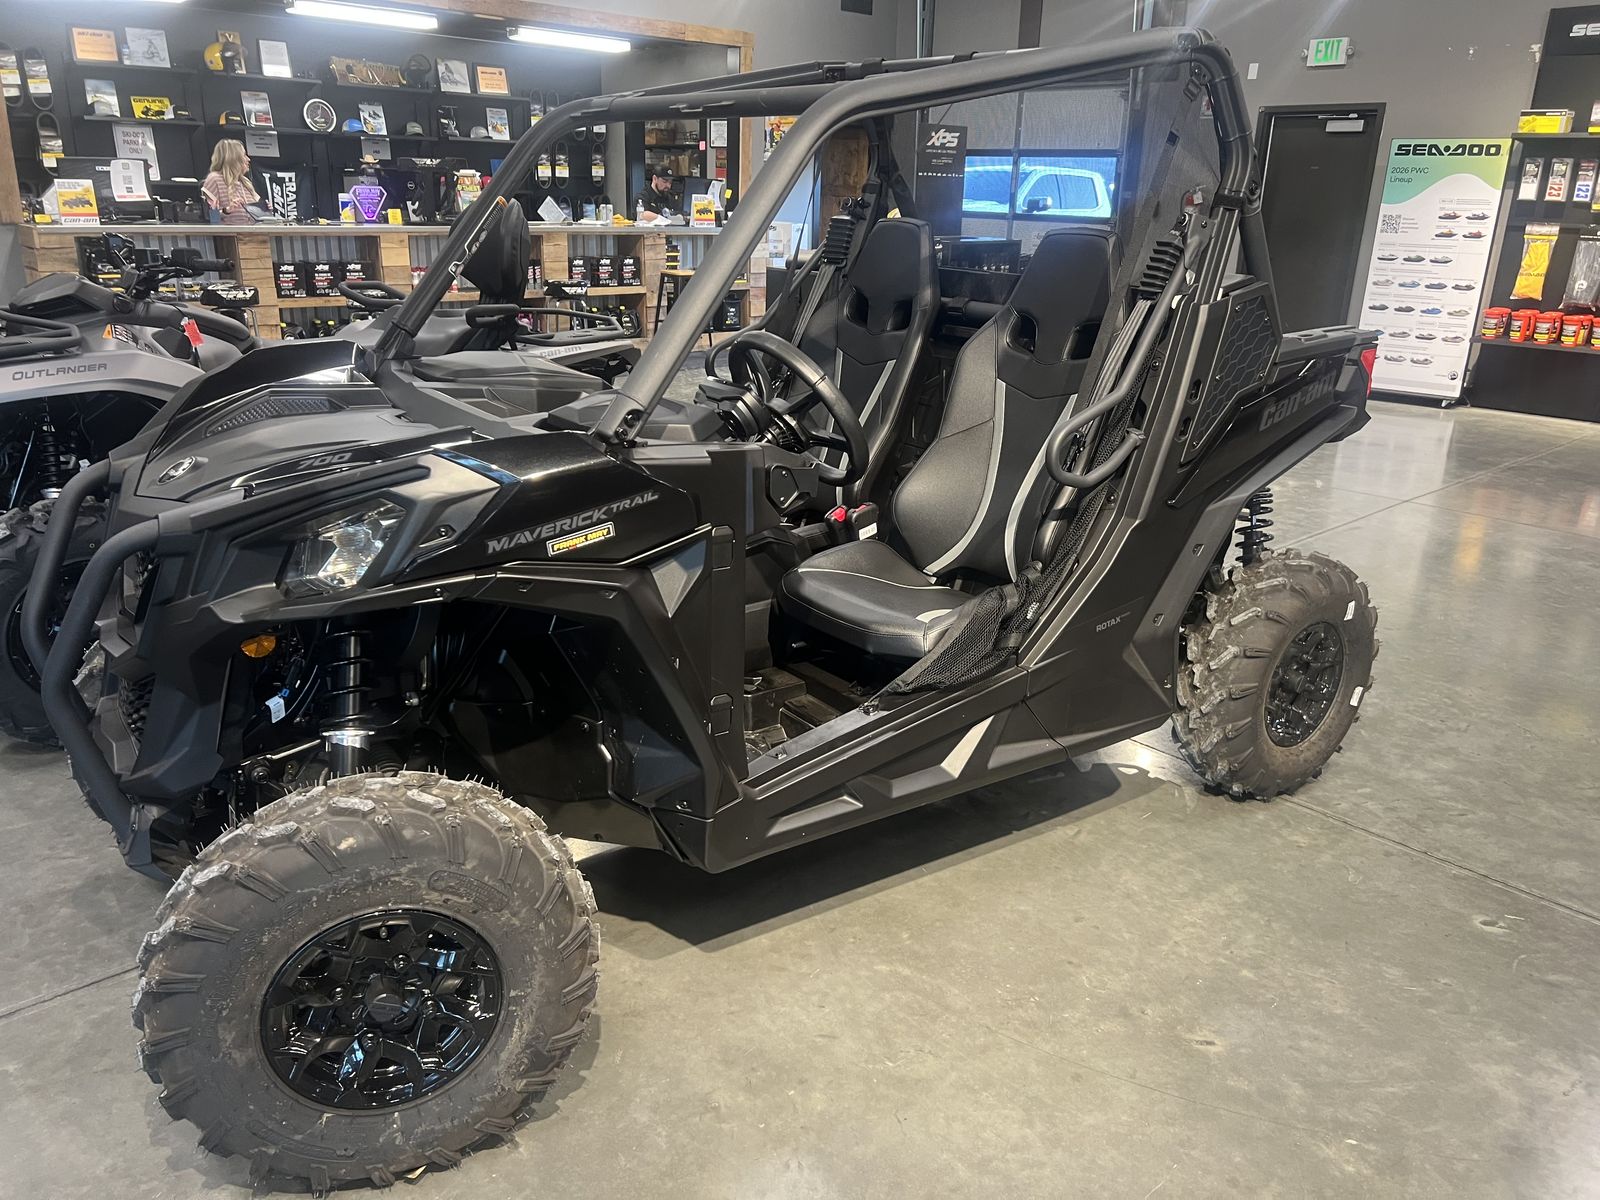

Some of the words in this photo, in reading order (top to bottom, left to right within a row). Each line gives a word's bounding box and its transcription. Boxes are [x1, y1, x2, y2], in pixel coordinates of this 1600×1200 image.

[1314, 39, 1343, 64] EXIT
[122, 139, 147, 147] PARKIG
[926, 128, 960, 147] XPS
[1575, 183, 1591, 199] 123
[12, 363, 108, 381] OUTLANDER
[297, 452, 352, 470] 700
[487, 506, 609, 554] MAVERICK
[611, 492, 660, 513] TRAIL
[552, 535, 588, 552] FRANK
[586, 528, 609, 542] MAY
[1096, 615, 1121, 632] ROTAX
